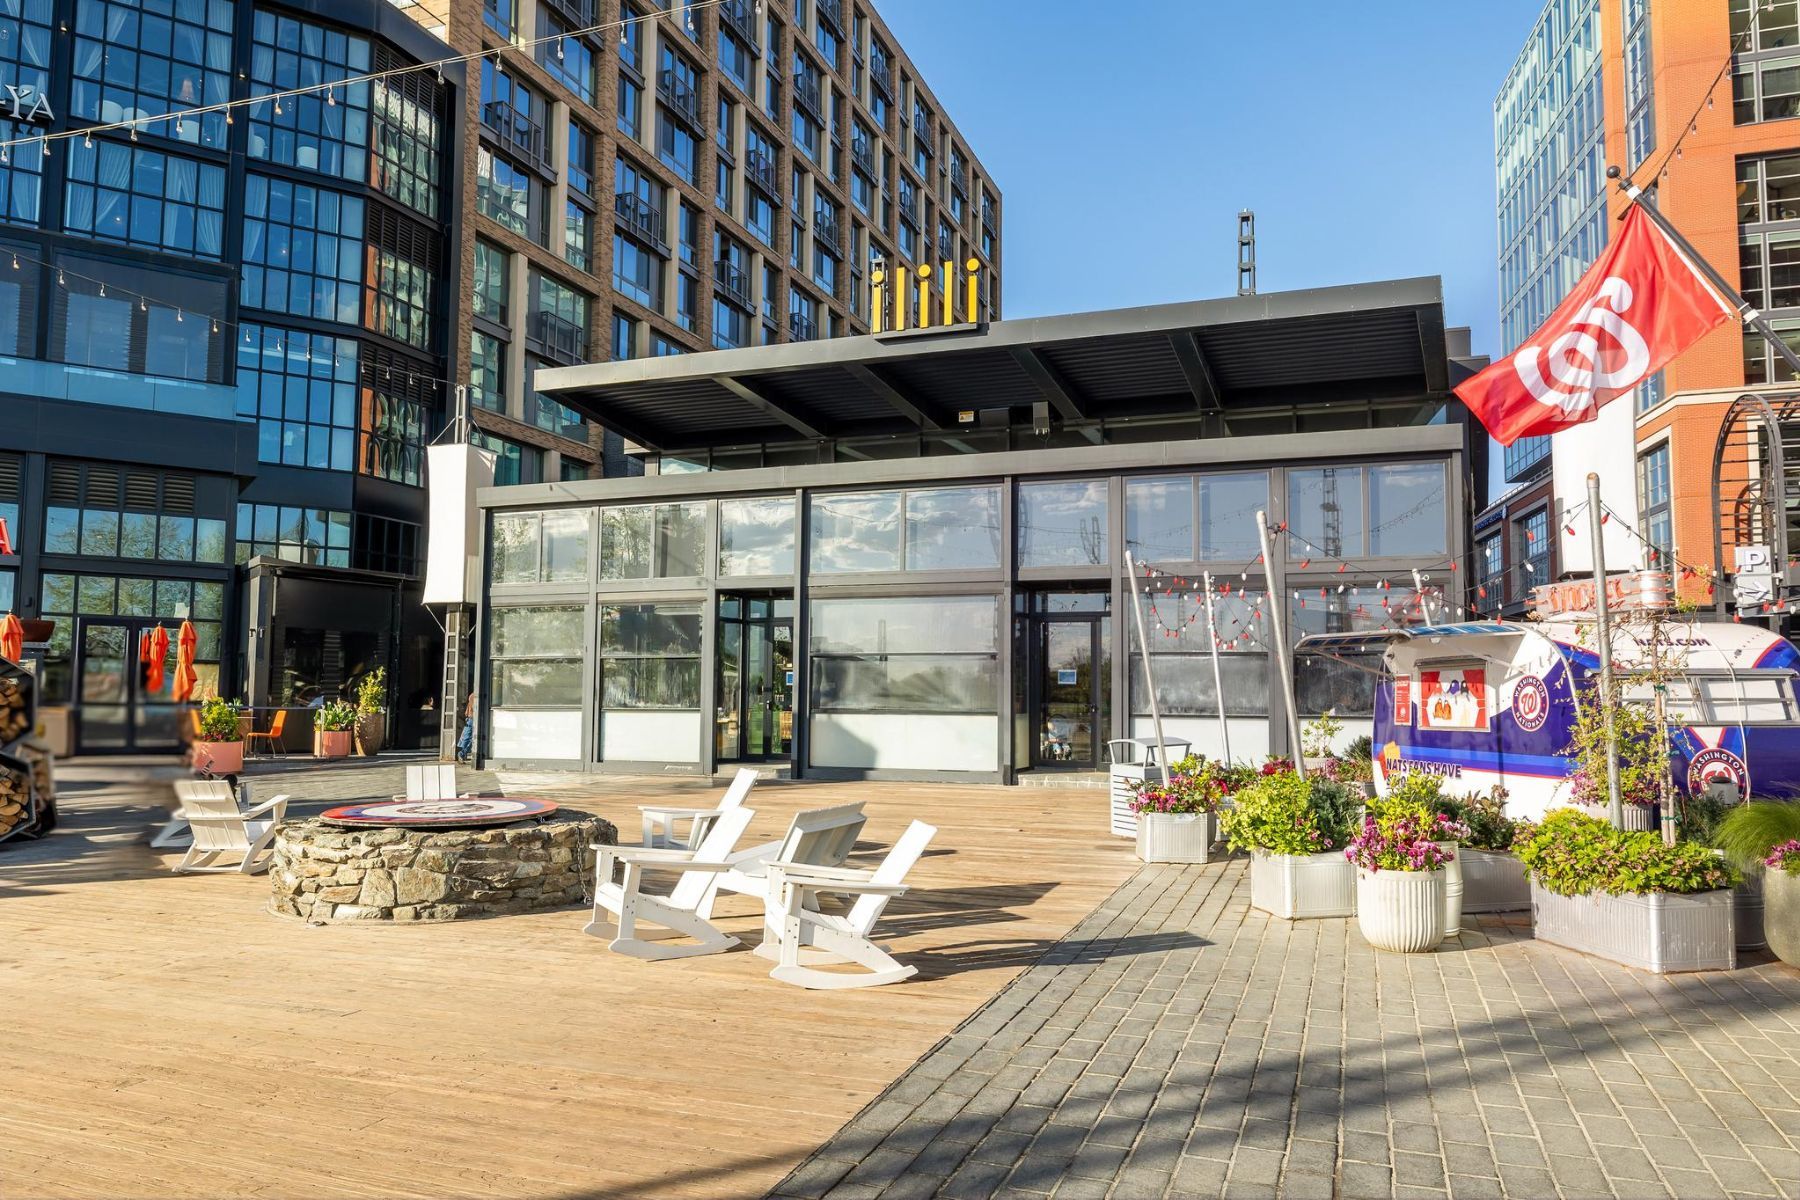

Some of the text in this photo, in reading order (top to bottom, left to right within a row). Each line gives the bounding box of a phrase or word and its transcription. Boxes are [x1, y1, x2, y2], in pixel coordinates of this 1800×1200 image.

[0, 84, 55, 122] YA
[872, 258, 979, 334] ilili
[1745, 550, 1766, 572] P
[1514, 677, 1546, 697] WASHINGTON
[1515, 711, 1545, 728] NATIONALS
[1386, 758, 1407, 772] NATS
[1433, 762, 1462, 778] HAVE
[1692, 751, 1745, 776] WASHINGTON
